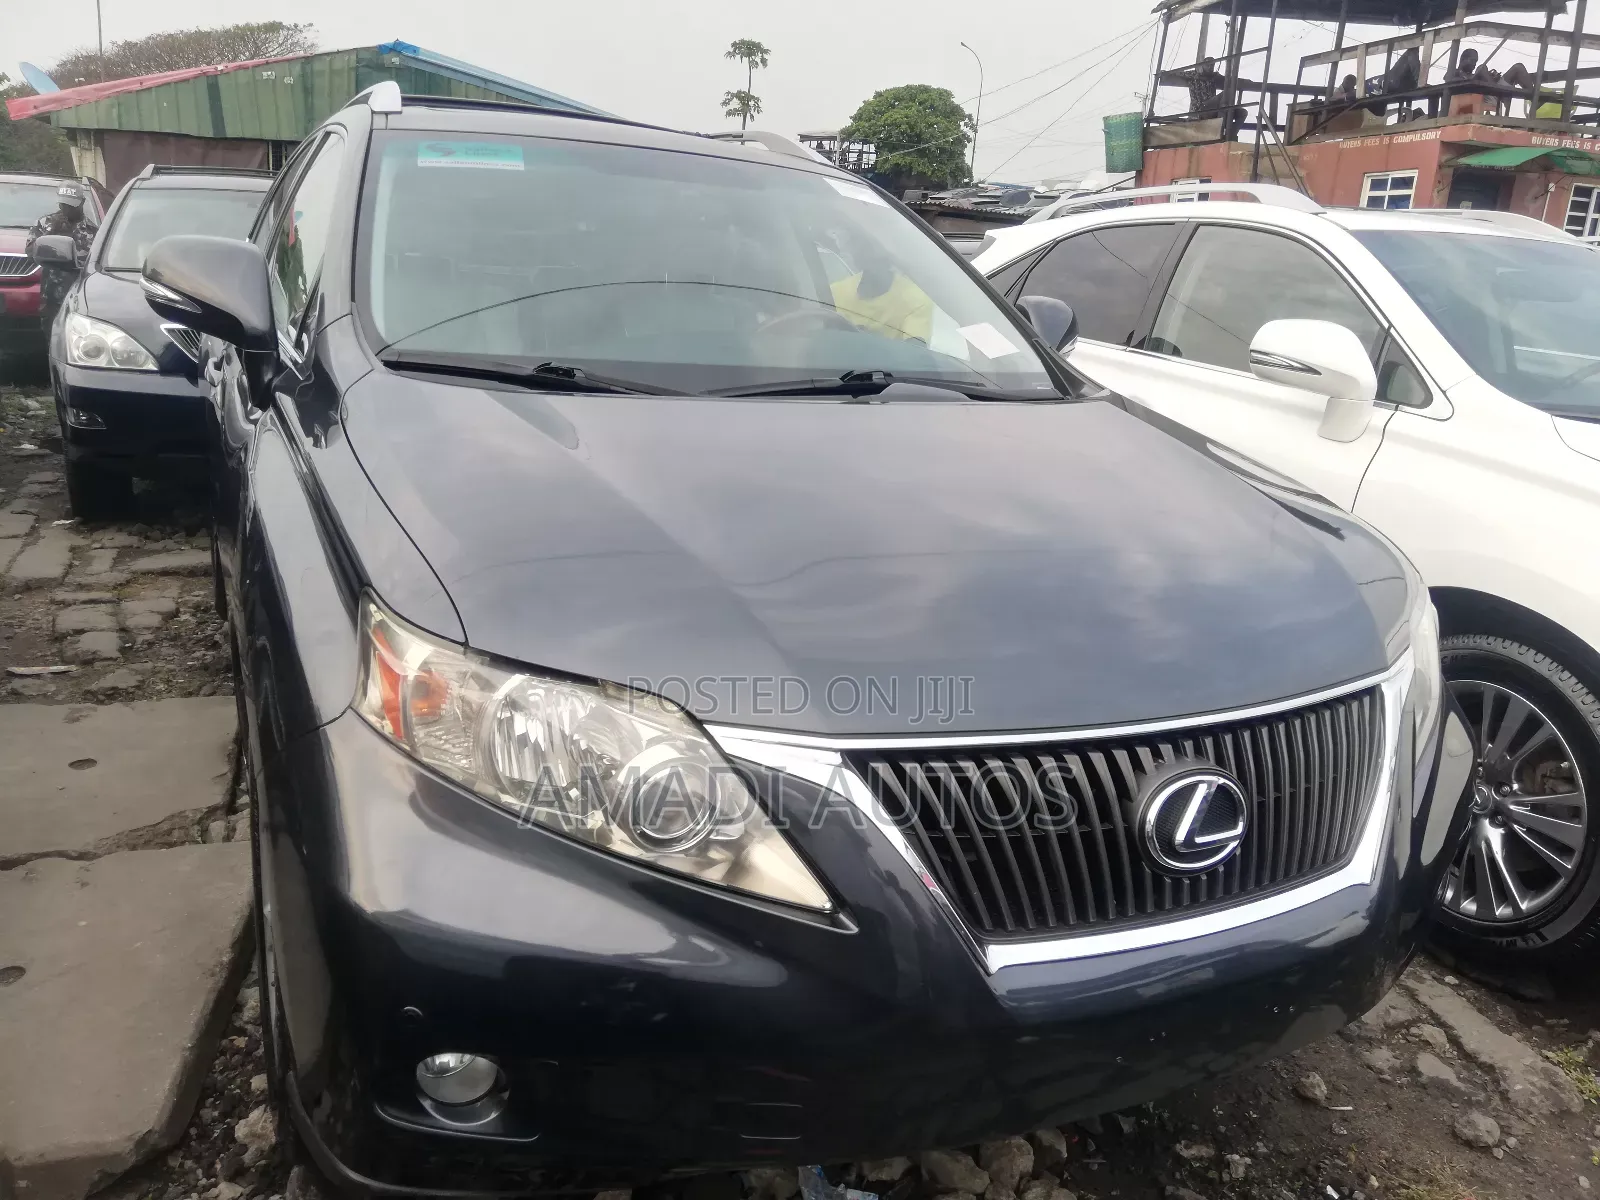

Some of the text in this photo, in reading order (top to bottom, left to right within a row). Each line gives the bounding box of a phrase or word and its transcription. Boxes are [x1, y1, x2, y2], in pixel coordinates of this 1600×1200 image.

[1364, 137, 1380, 147] FEES
[1383, 136, 1390, 145] IS
[1393, 130, 1442, 144] COMPULSORY
[1531, 136, 1560, 147] BUYERS
[1562, 139, 1580, 149] FEES
[1583, 141, 1592, 150] IS
